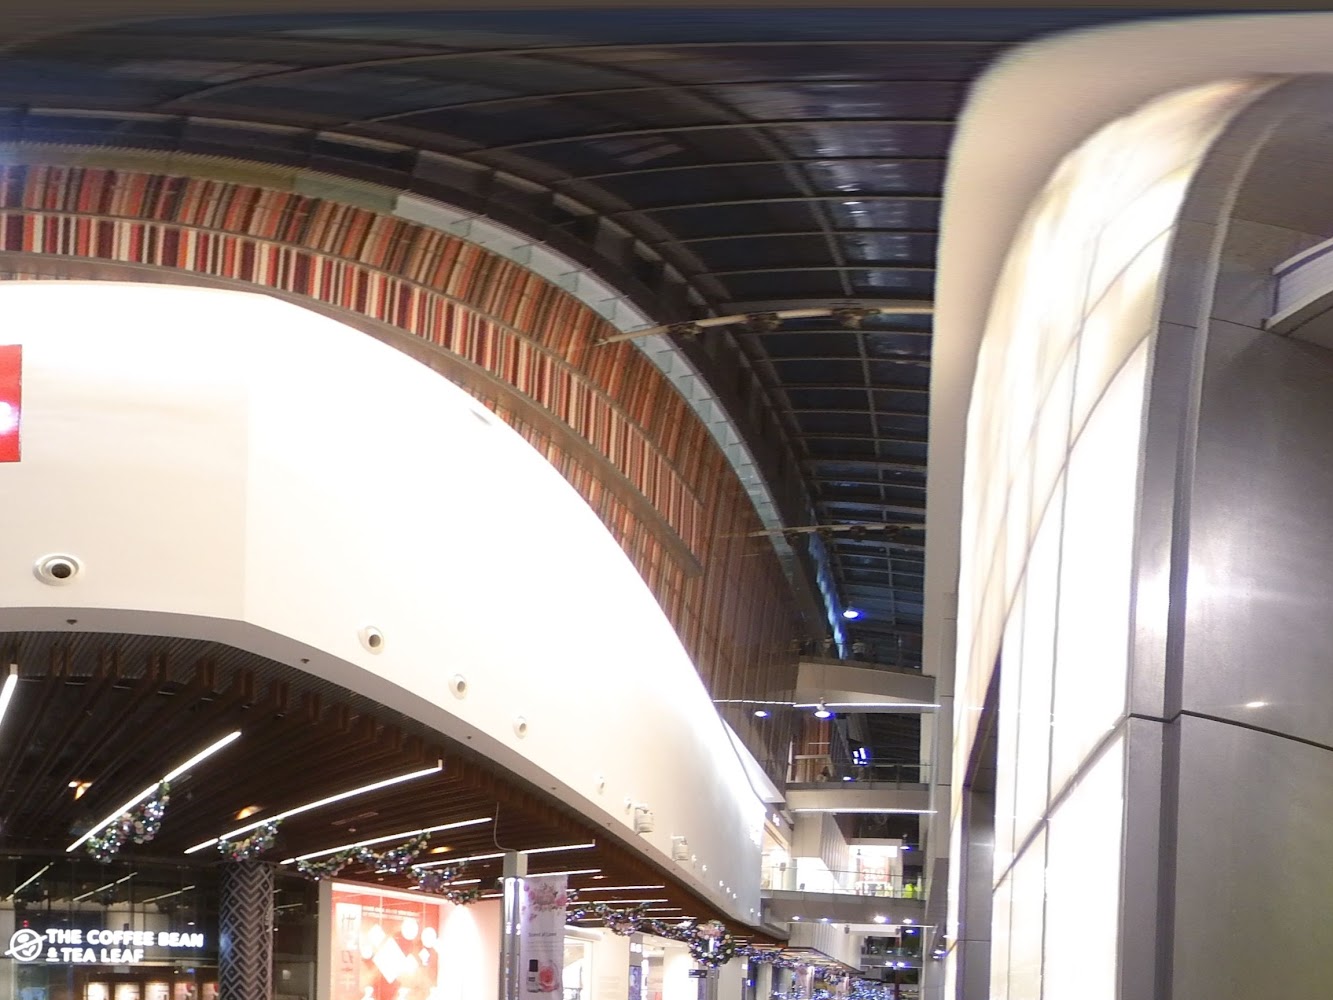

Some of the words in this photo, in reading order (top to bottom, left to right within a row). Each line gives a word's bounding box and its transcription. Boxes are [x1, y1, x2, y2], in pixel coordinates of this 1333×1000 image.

[46, 929, 82, 944] THE
[86, 929, 154, 946] COFFEE
[157, 932, 204, 948] BEAN
[61, 947, 96, 962] TEA
[100, 948, 144, 963] LEAF
